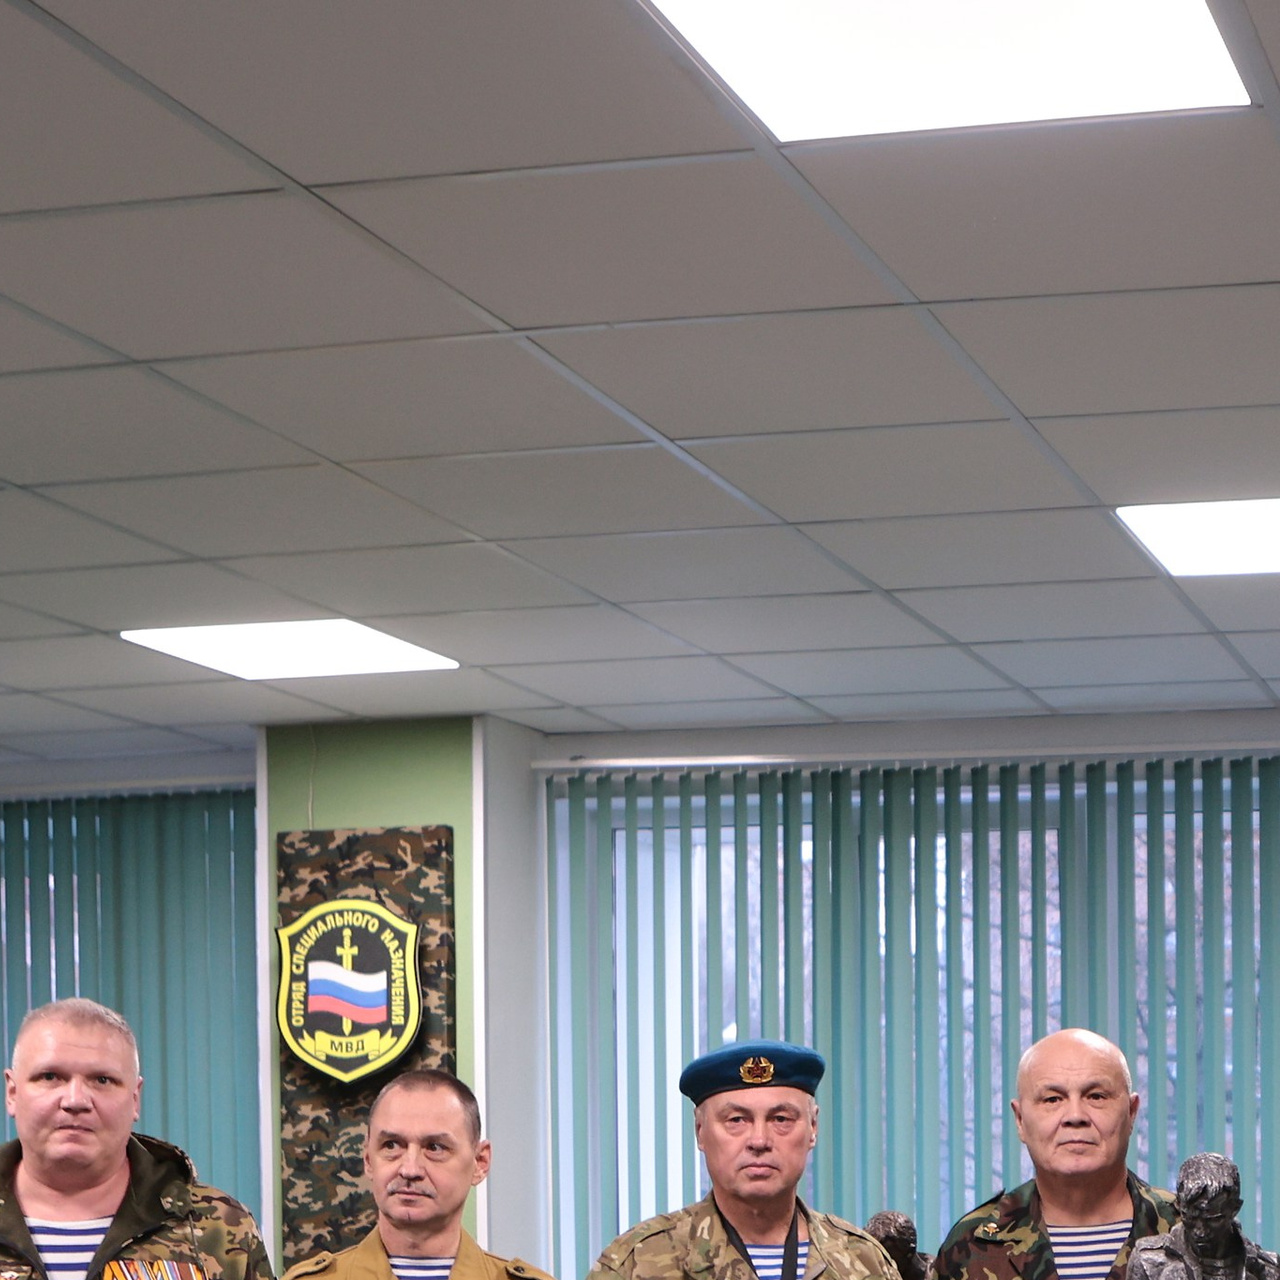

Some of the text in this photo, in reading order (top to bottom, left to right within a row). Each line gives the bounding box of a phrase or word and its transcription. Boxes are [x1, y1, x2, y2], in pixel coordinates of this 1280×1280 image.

[291, 910, 405, 1027] ОТРЯД СПЕЦИАЛЬНОГО НАЗНАЧЕНИЯ
[329, 1039, 365, 1054] МВД
